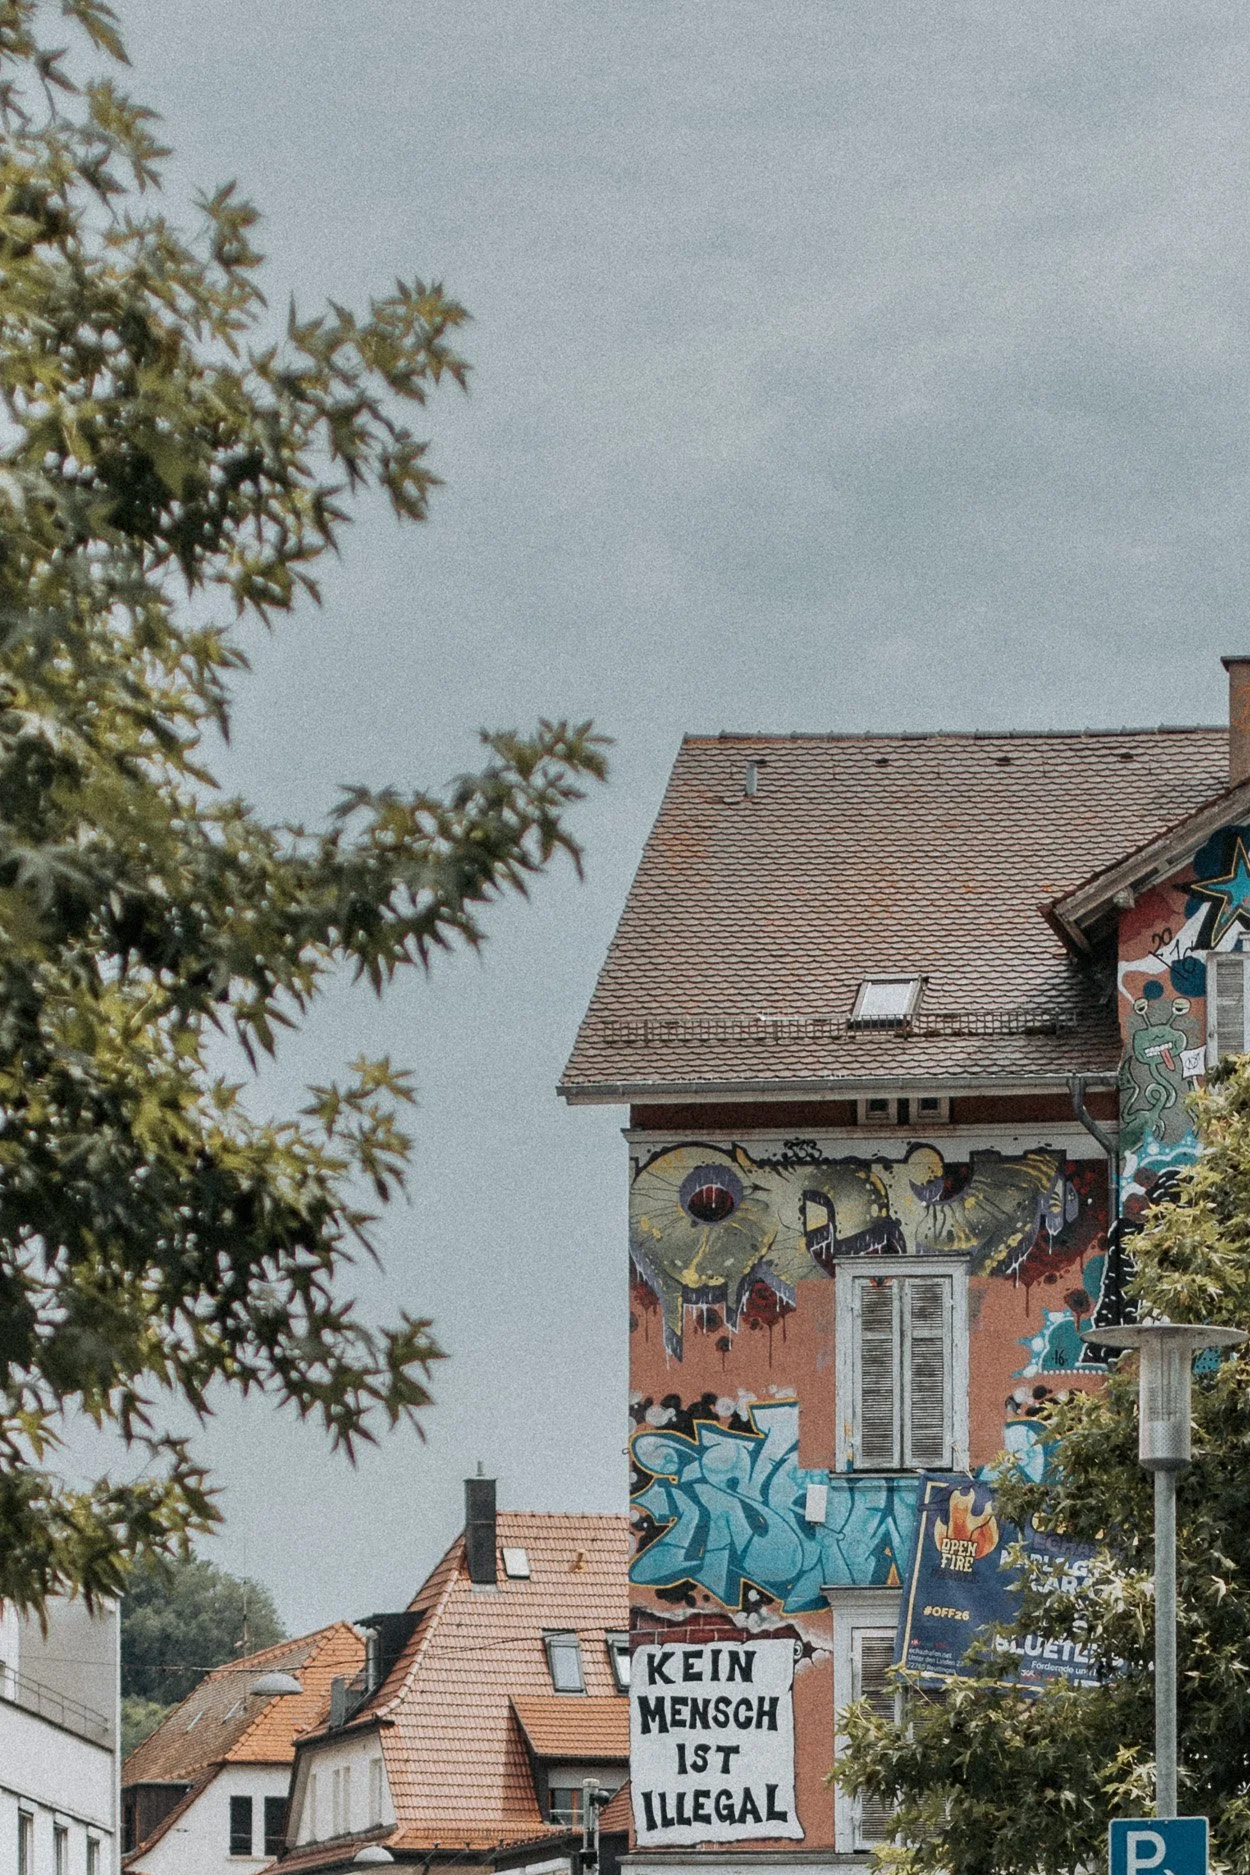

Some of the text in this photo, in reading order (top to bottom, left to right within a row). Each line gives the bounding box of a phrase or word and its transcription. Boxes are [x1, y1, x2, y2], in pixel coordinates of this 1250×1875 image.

[941, 1553, 974, 1573] FIRE
[942, 1539, 978, 1557] OPEN
[924, 1605, 970, 1621] #OFF26
[646, 1649, 757, 1685] KEIN
[637, 1695, 780, 1735] MENSCH
[676, 1743, 740, 1775] IST
[641, 1783, 788, 1832] ILLEGAL
